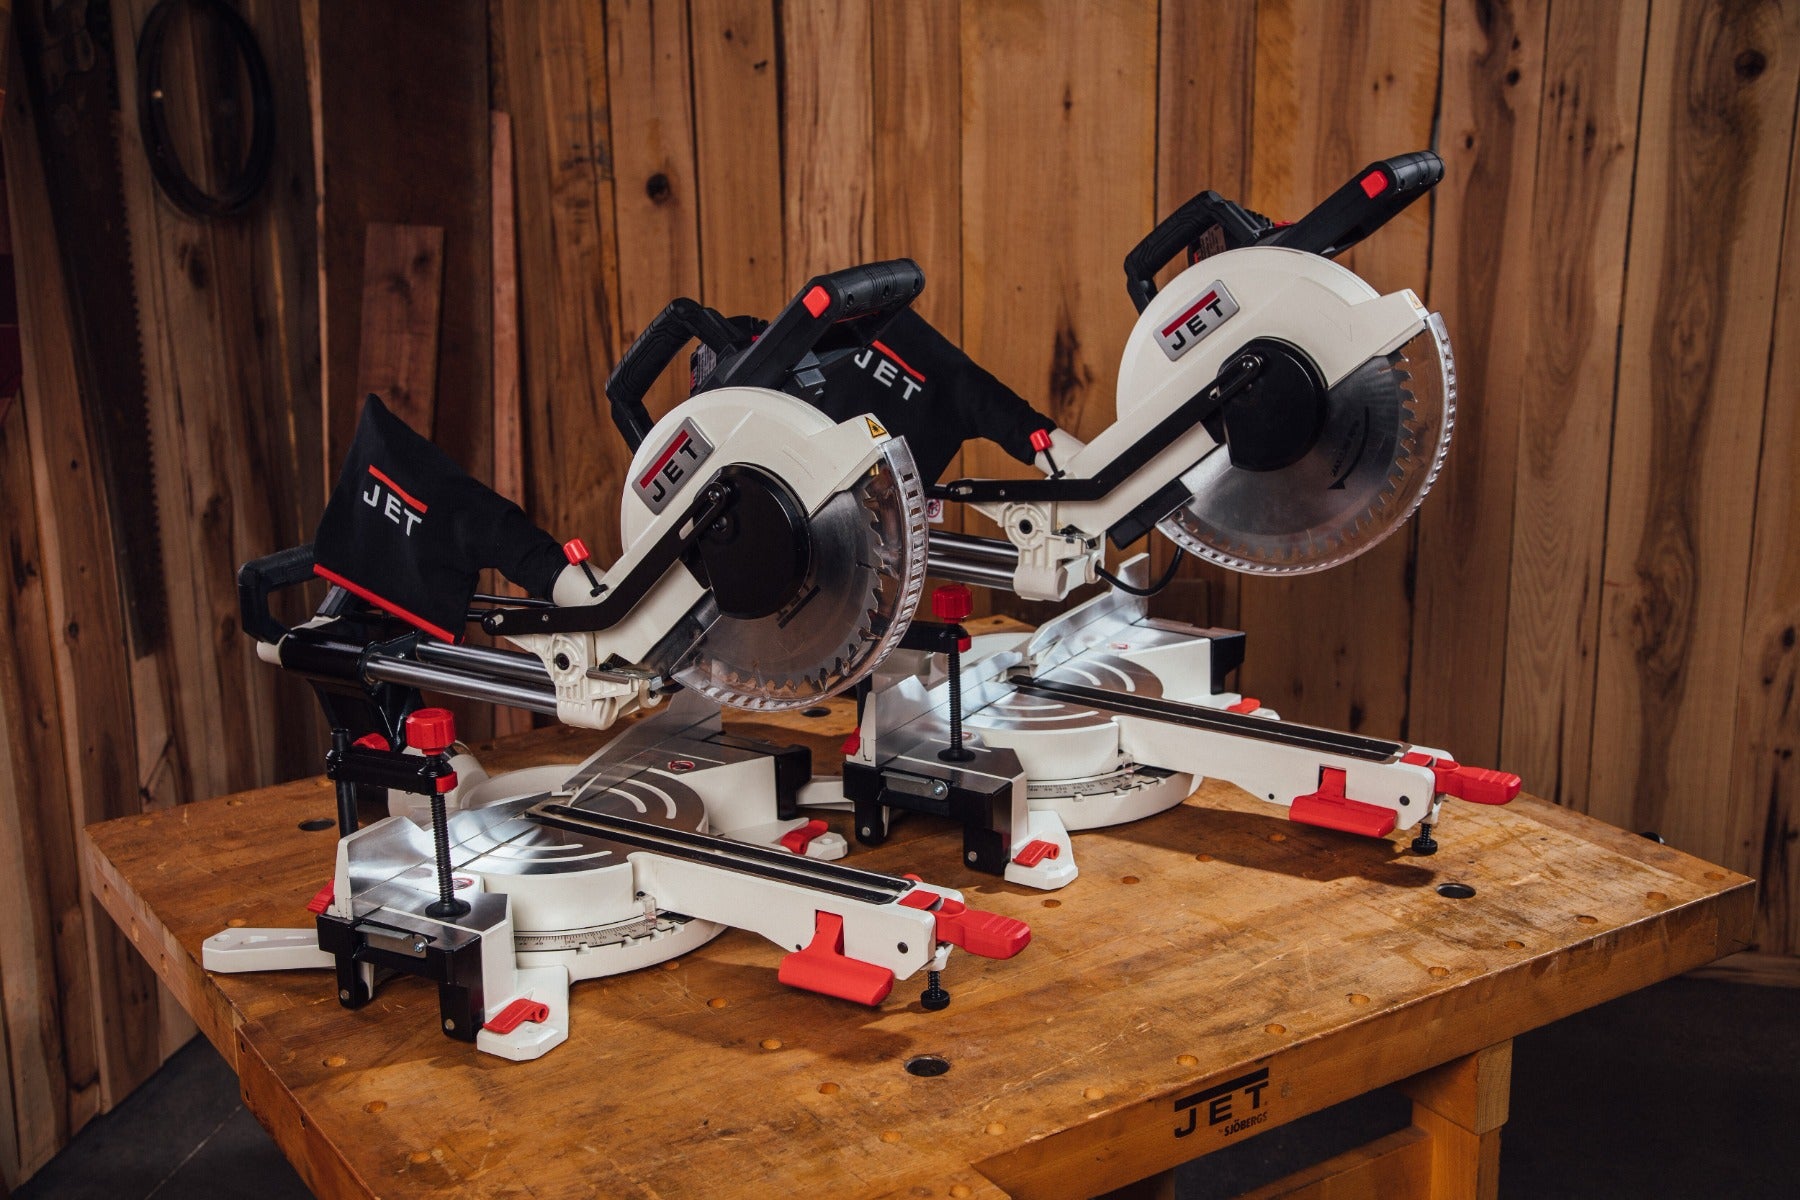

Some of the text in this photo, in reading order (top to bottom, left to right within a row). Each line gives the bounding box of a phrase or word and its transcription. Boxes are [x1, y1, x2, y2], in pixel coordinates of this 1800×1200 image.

[1171, 297, 1223, 351] JET
[854, 349, 922, 401] JET
[652, 437, 698, 503] JET
[363, 484, 423, 537] JET
[1174, 1081, 1268, 1138] JET
[1224, 1111, 1267, 1136] SJÖBERGS
